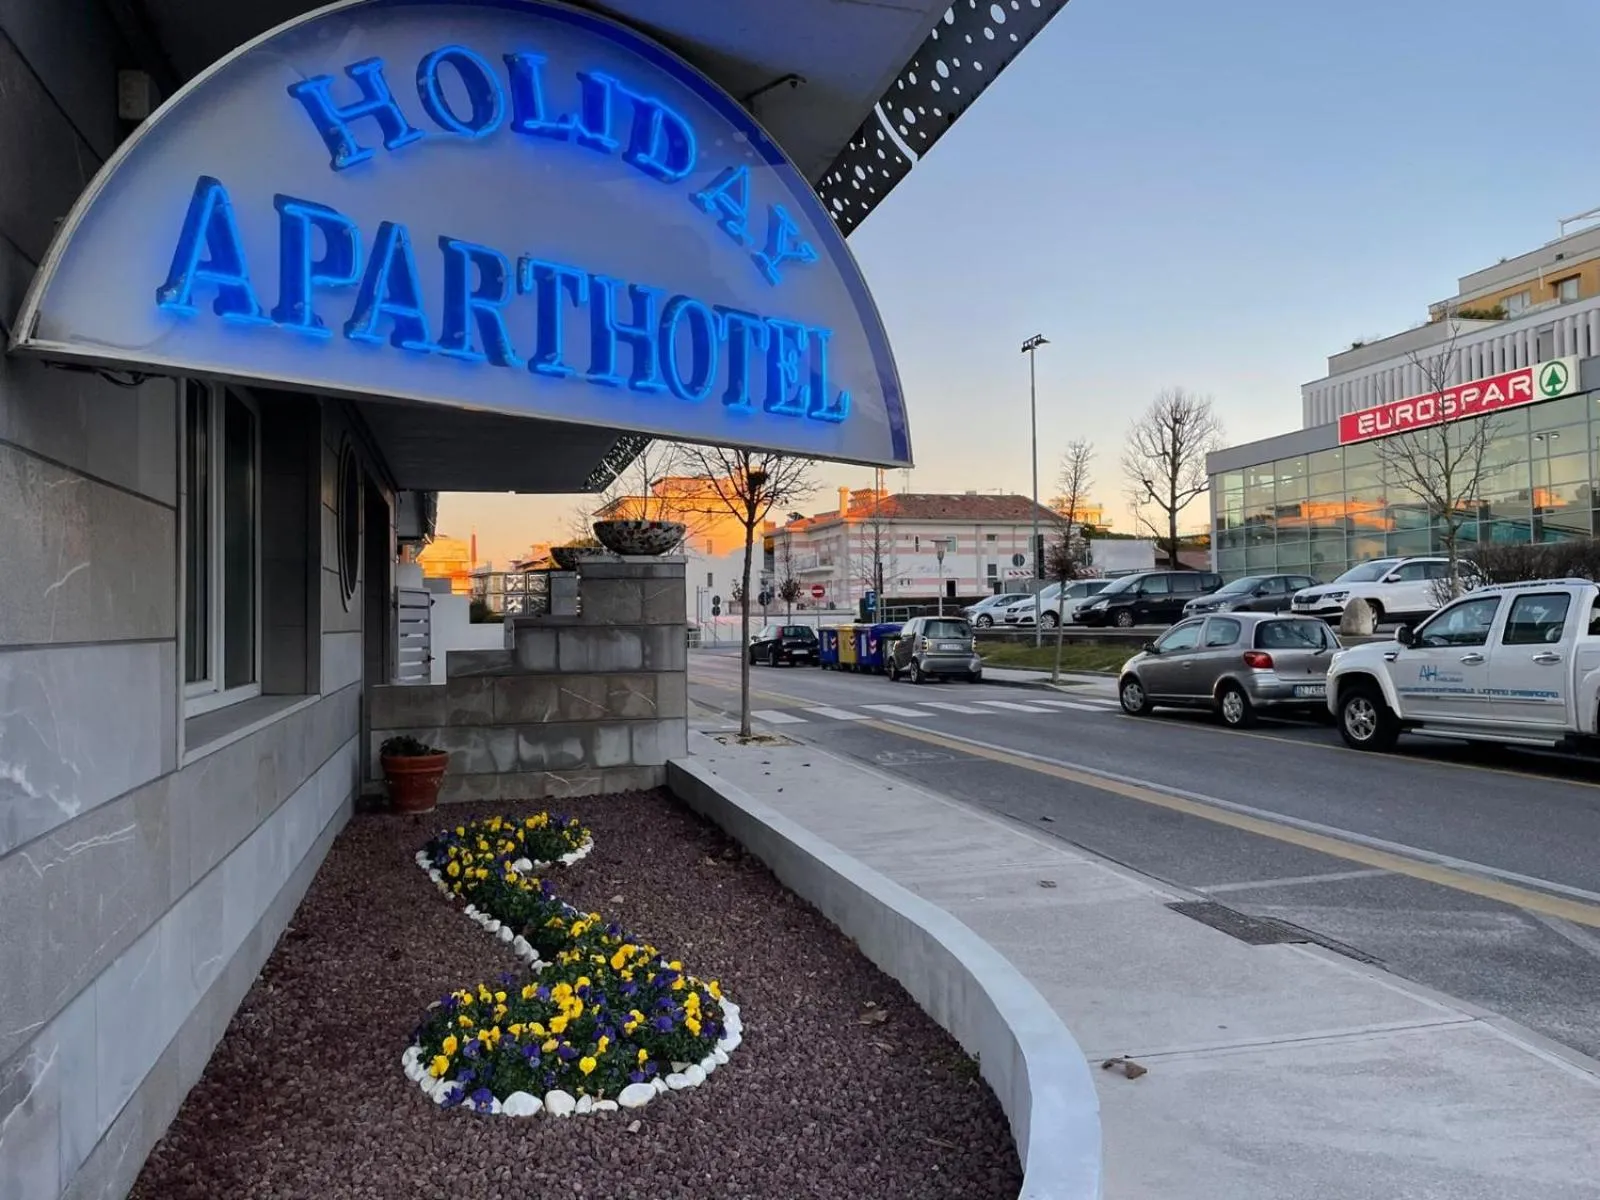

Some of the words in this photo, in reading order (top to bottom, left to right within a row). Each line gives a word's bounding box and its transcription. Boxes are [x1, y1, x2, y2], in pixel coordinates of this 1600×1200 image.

[288, 43, 819, 286] HOLIDAY
[156, 175, 851, 423] APARTHOTEL
[1357, 375, 1532, 435] EUROSPAR
